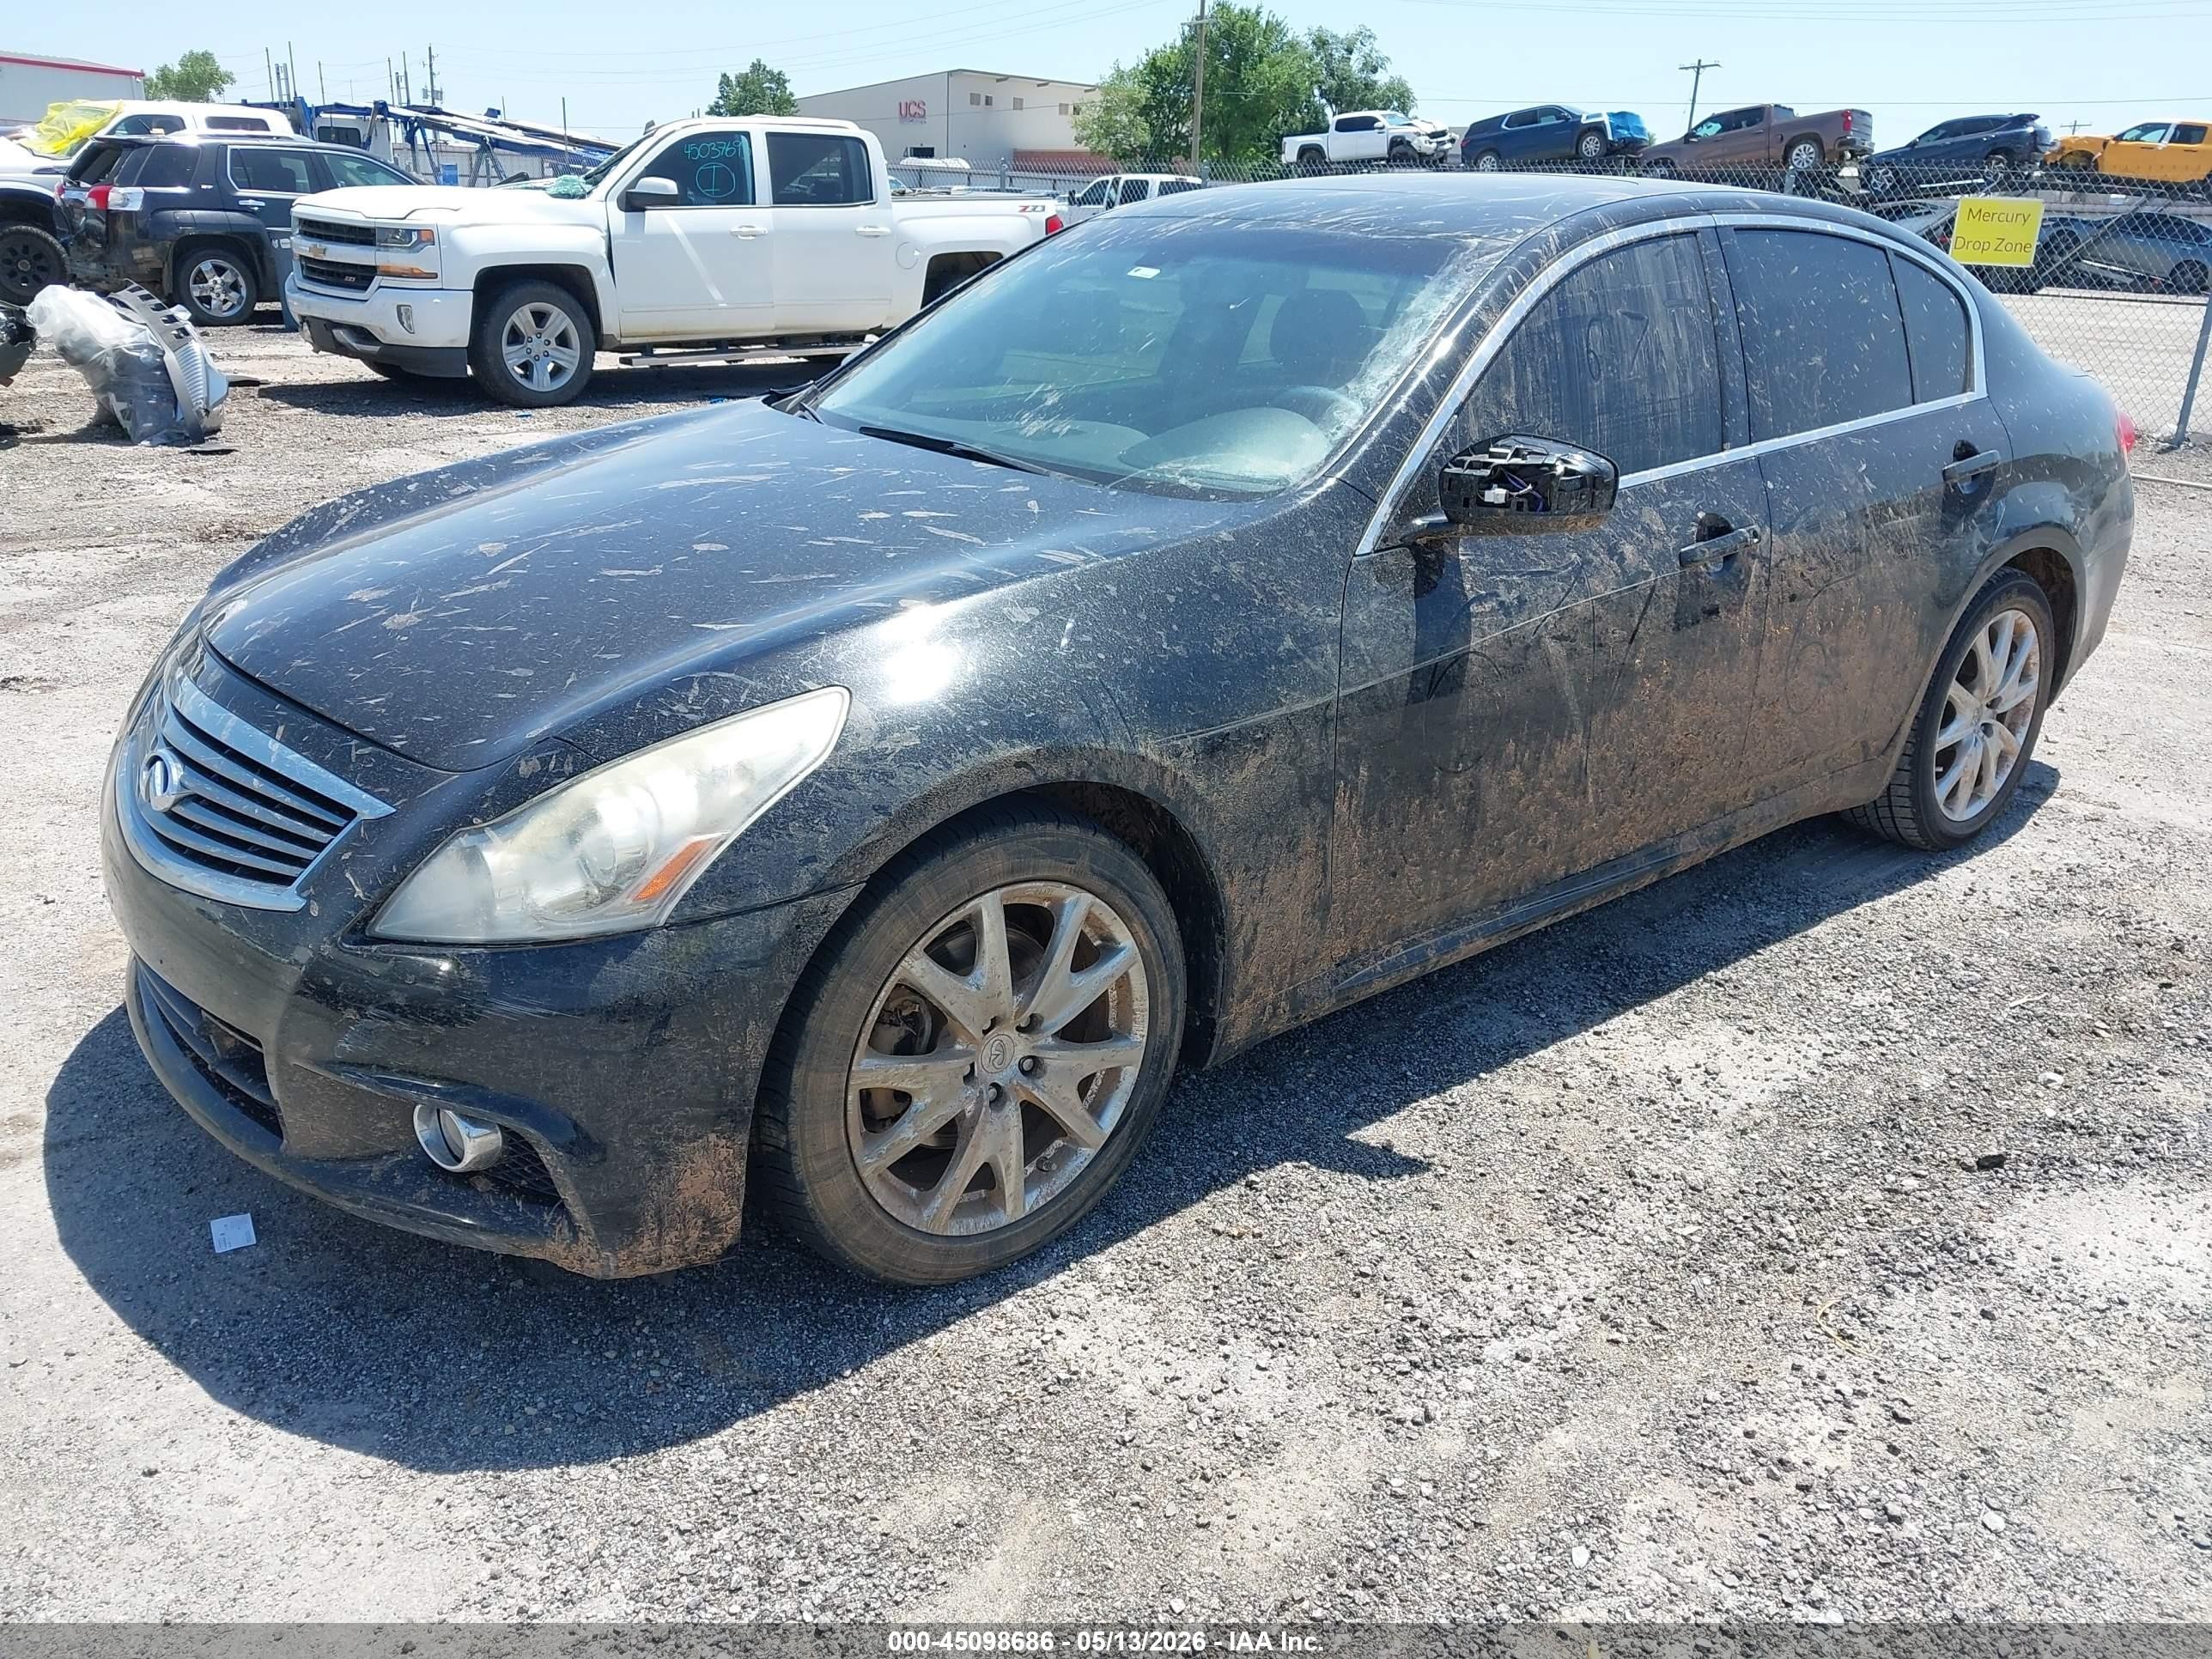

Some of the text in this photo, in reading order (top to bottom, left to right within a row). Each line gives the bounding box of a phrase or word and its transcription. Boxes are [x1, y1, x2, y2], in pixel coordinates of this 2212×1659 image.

[898, 100, 927, 118] UCS
[1967, 207, 2032, 226] Mercury
[1954, 235, 2033, 254] Drop Zone
